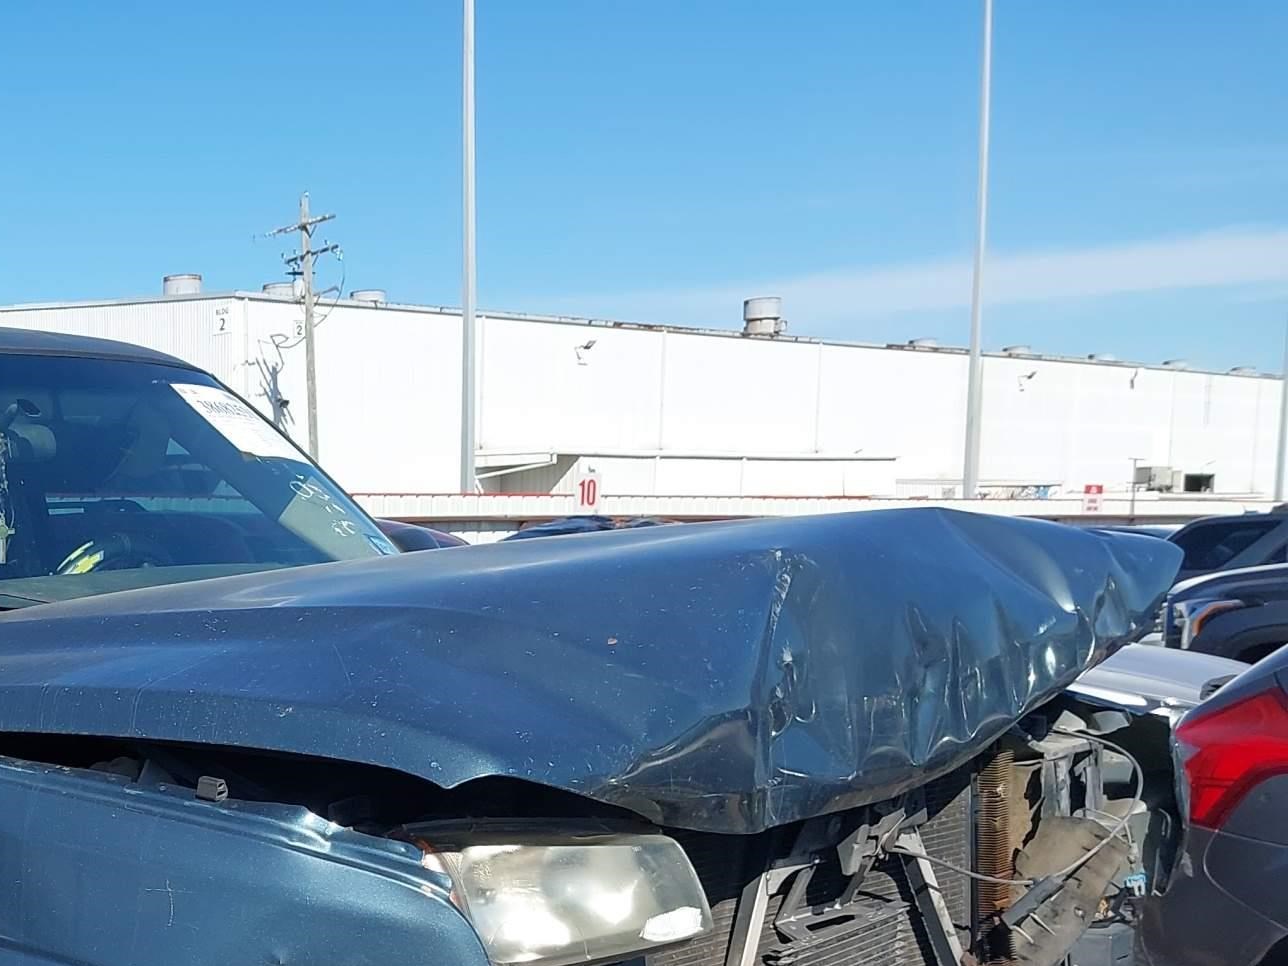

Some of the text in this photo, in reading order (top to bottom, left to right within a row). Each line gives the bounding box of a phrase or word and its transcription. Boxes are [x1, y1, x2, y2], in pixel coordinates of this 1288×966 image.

[219, 317, 226, 331] 2
[296, 325, 303, 335] 2
[578, 479, 597, 506] 10
